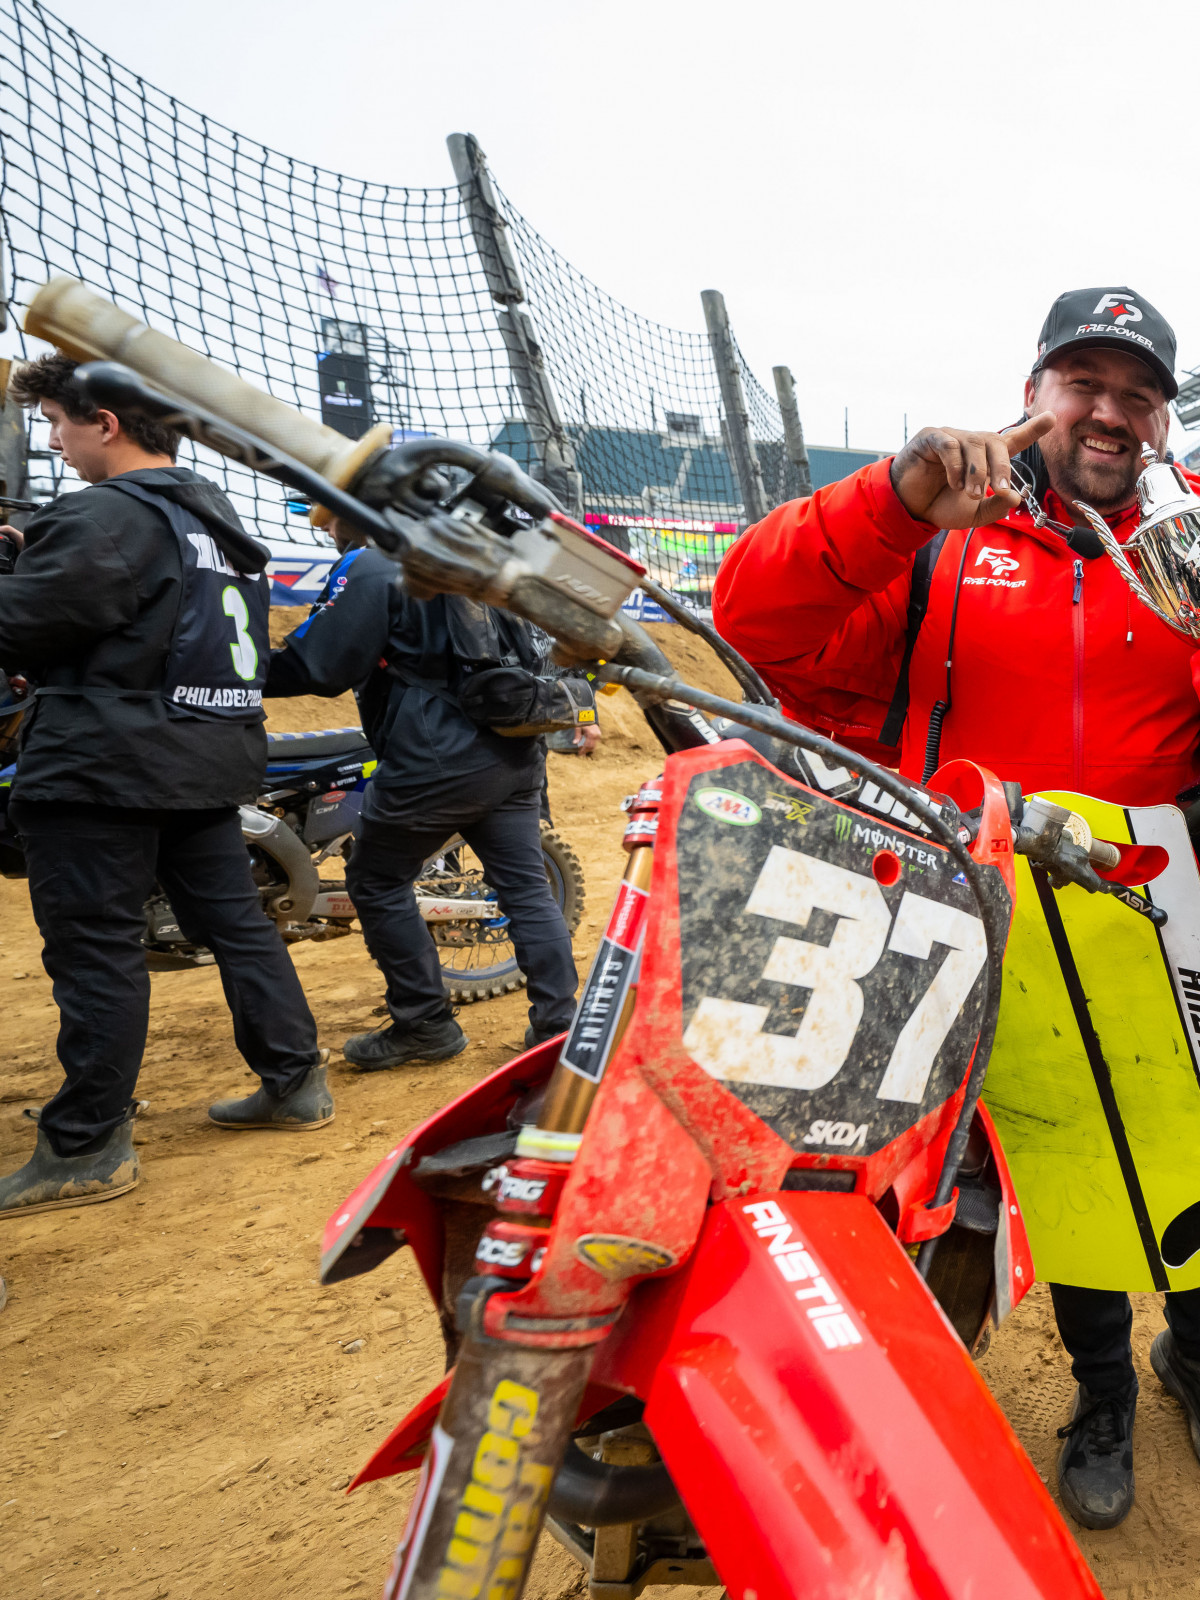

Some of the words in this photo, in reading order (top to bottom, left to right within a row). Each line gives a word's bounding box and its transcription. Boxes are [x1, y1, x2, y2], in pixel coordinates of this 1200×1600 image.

[222, 585, 258, 681] 3
[705, 796, 751, 820] AMA
[854, 823, 938, 870] MONSTER
[576, 961, 623, 1053] GENUINE
[682, 844, 988, 1104] 37
[803, 1119, 869, 1147] SKDA
[742, 1200, 863, 1349] ANSTIE
